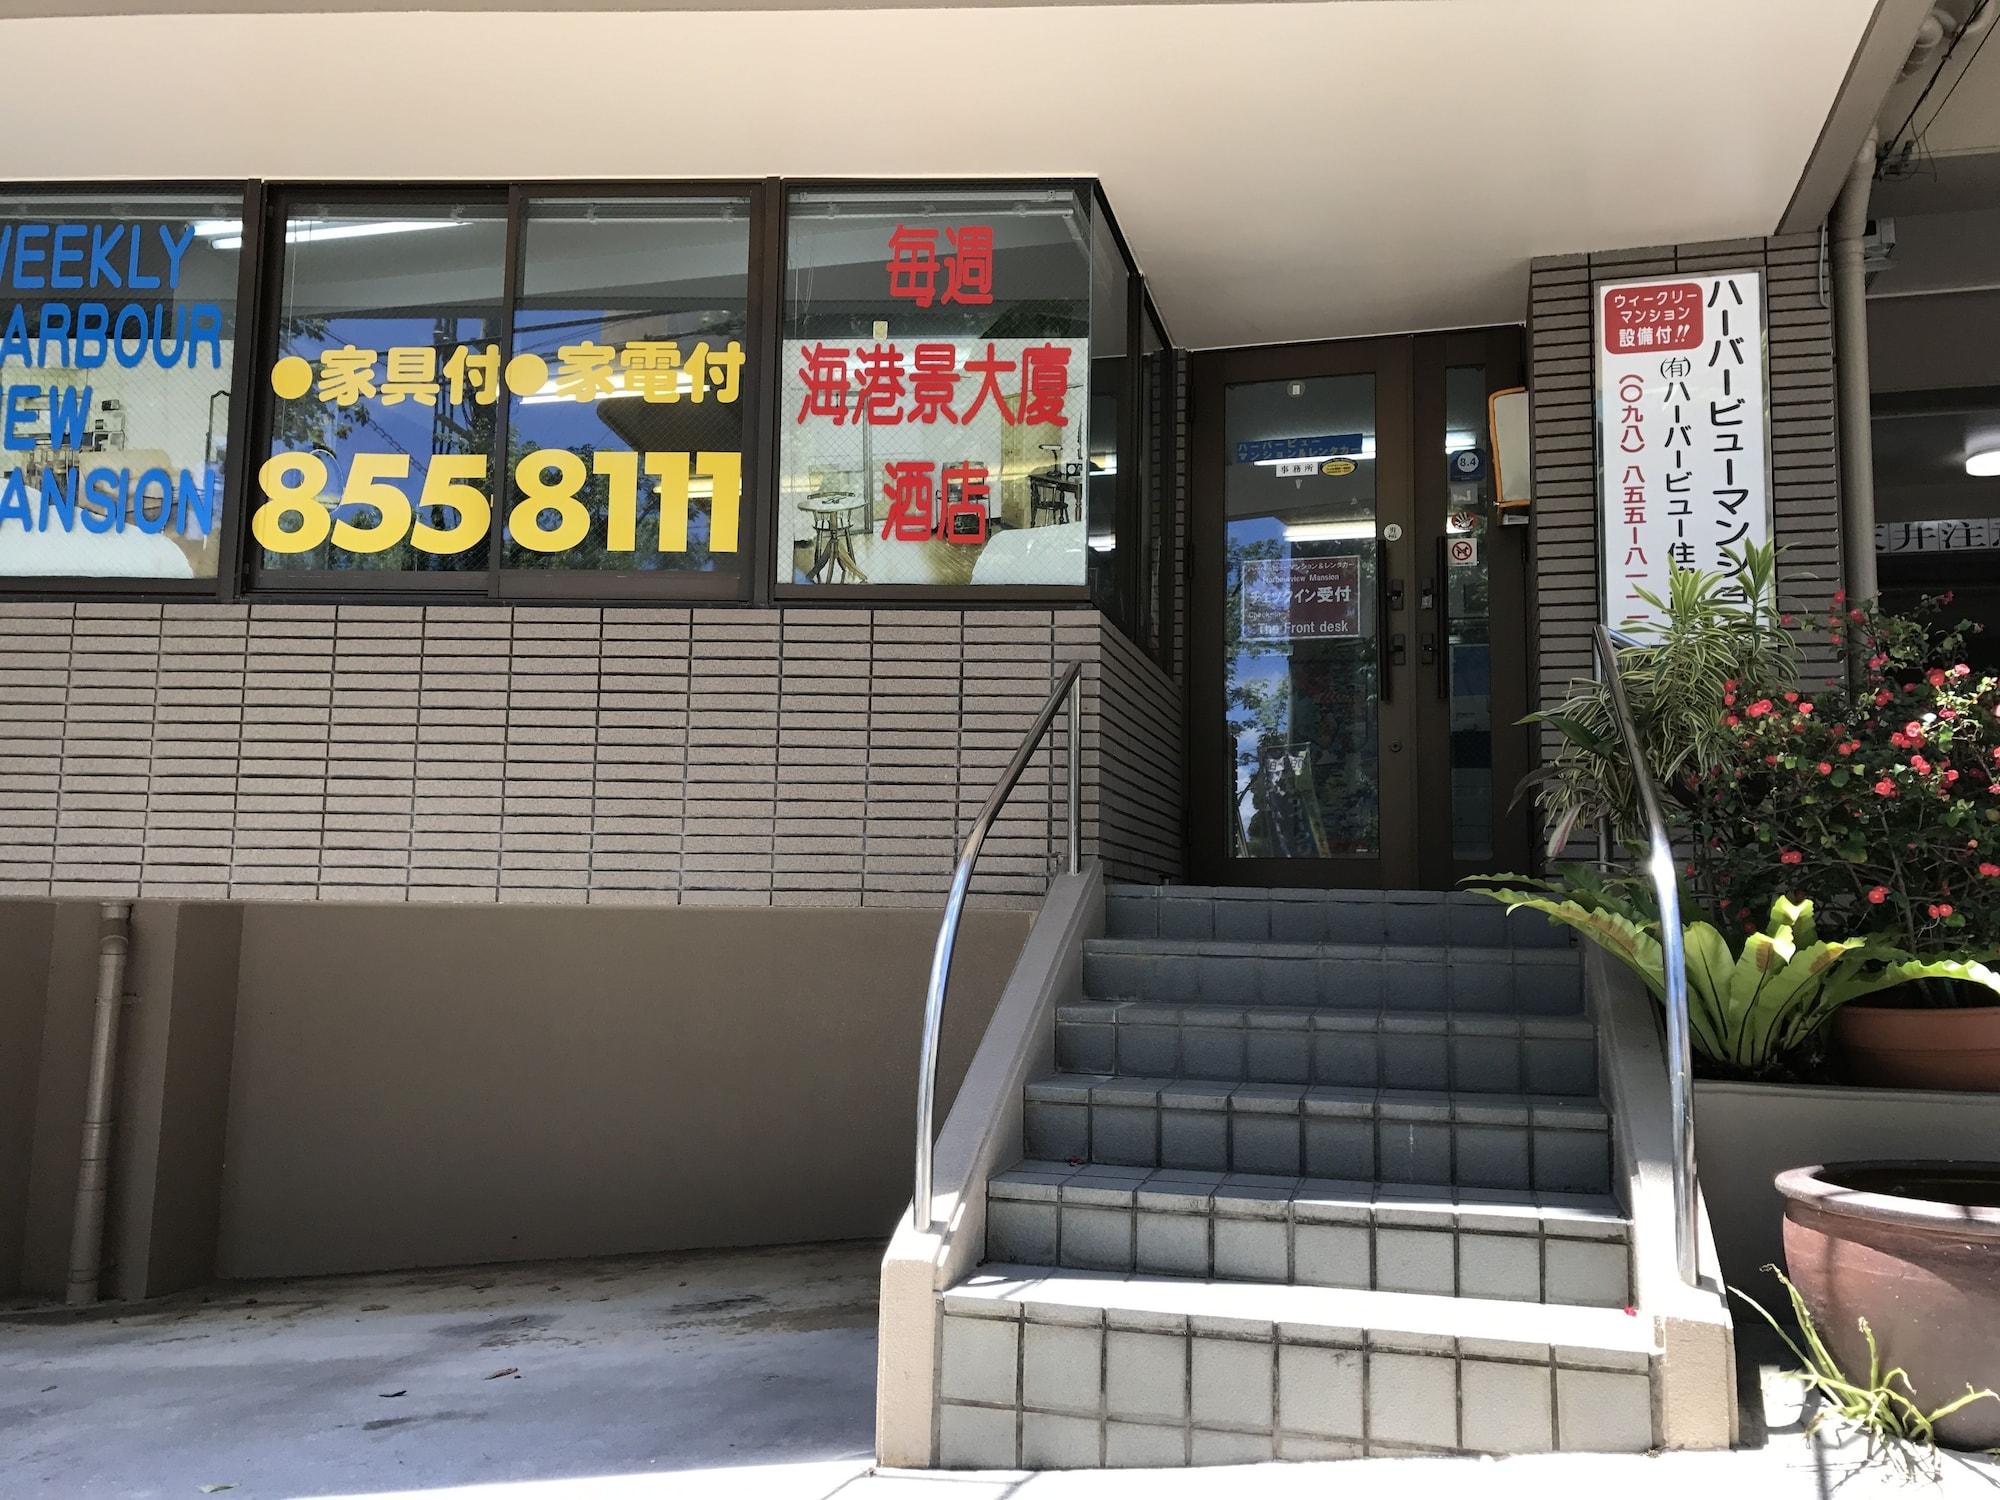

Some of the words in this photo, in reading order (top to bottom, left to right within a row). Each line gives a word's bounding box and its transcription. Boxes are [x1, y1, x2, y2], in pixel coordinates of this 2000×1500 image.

[887, 224, 993, 307] 毎週
[1614, 290, 1698, 309] ウィークリー
[1620, 307, 1690, 324] マンション
[319, 344, 500, 406] 家具付
[556, 341, 746, 404] 家電付
[0, 385, 93, 451] EW
[1459, 458, 1476, 467] 8.4
[252, 453, 492, 555] 855
[508, 450, 742, 553] 8111
[881, 461, 991, 544] 酒店
[1284, 621, 1316, 634] Front
[1319, 620, 1349, 633] desk
